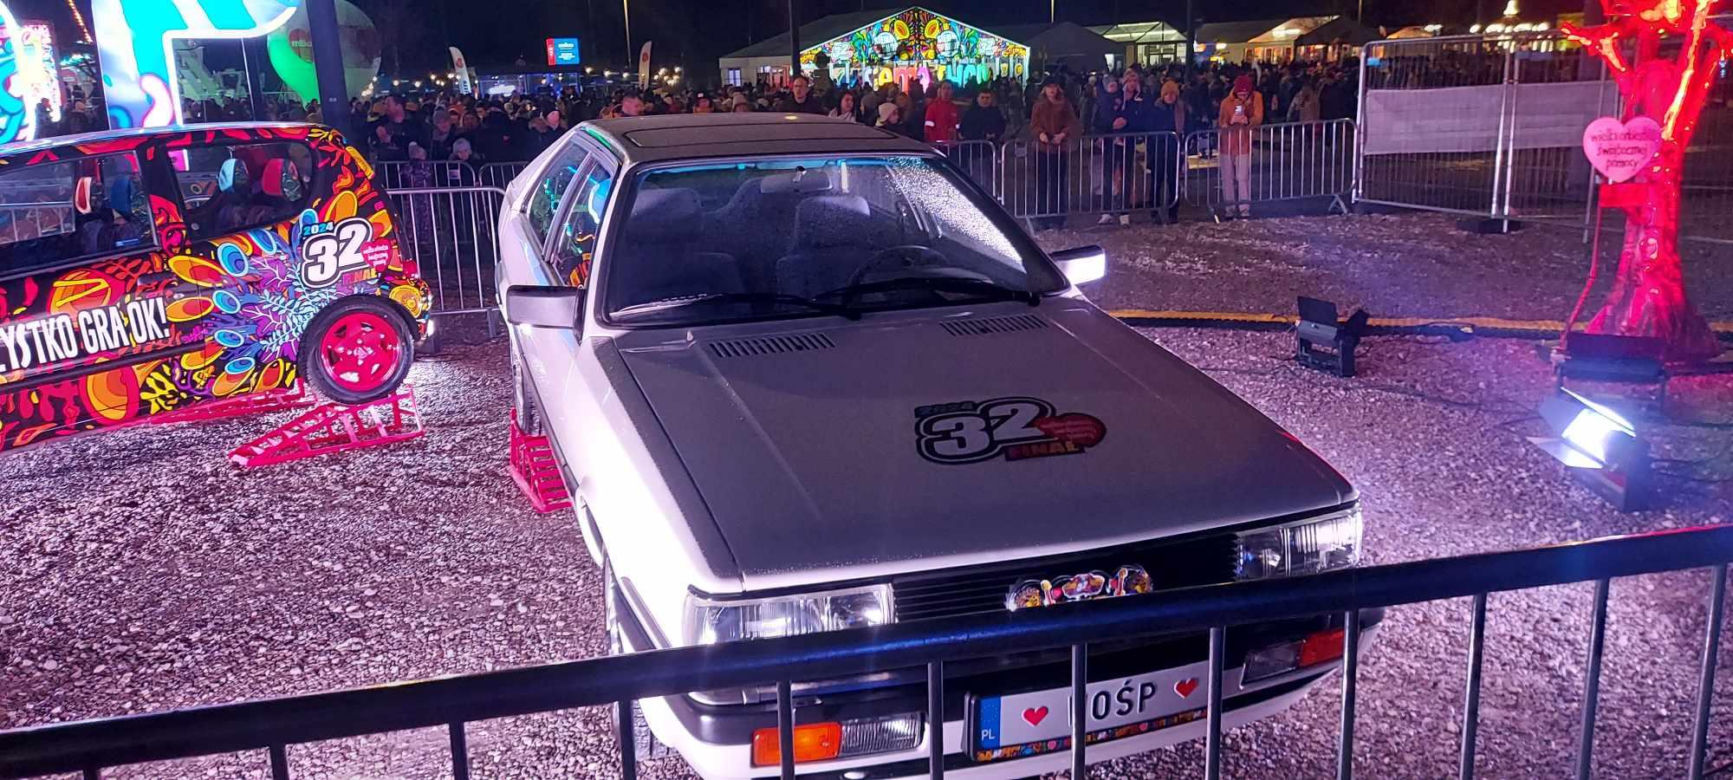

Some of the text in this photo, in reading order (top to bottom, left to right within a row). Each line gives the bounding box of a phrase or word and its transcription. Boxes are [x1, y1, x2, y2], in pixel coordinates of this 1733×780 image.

[303, 221, 334, 236] 2024
[305, 221, 370, 285] 32
[342, 268, 378, 285] FINAL
[0, 297, 170, 372] YSTKO GRA OK!
[924, 400, 1048, 461] 32
[1009, 441, 1081, 459] FINAL
[1068, 679, 1157, 727] OŚP
[980, 728, 996, 741] PL
